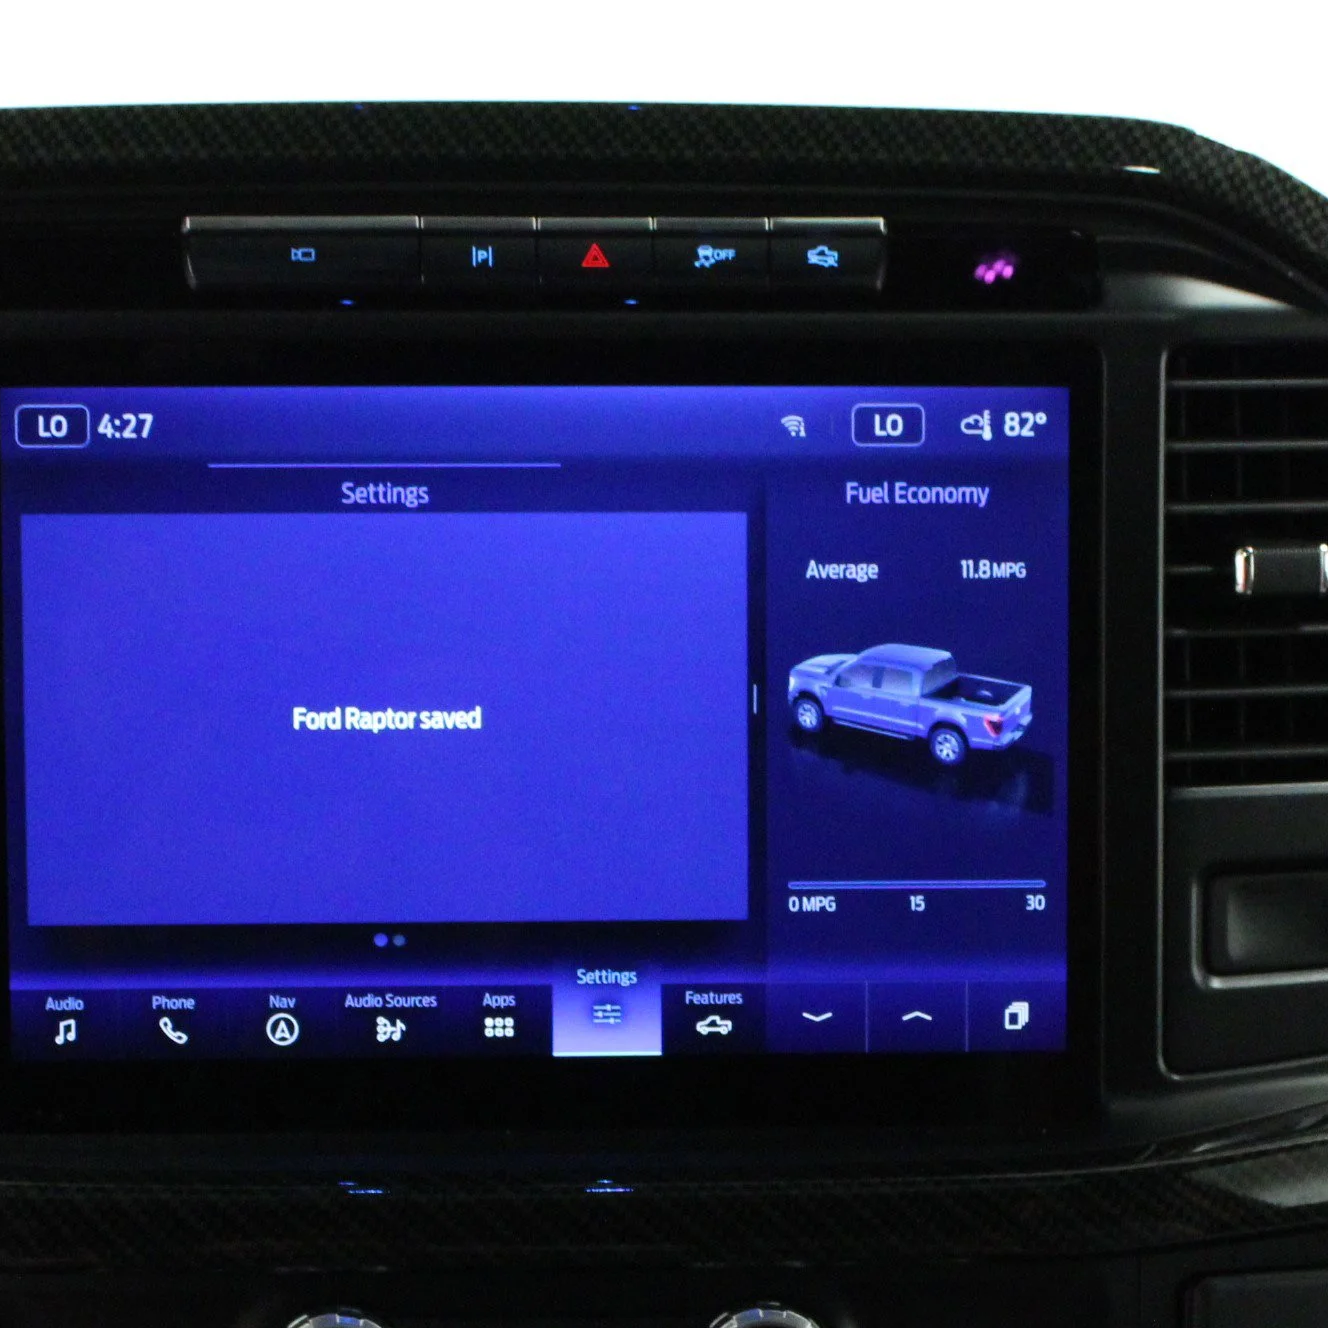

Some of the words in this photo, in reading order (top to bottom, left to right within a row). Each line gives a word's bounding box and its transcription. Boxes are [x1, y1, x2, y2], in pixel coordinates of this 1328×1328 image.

[713, 248, 736, 260] OFF
[37, 415, 67, 438] LO
[97, 414, 153, 439] 4:27
[874, 414, 903, 436] LO
[1004, 410, 1046, 436] 82°
[341, 482, 429, 507] Settings
[846, 482, 889, 503] Fuel
[895, 482, 989, 507] Economy
[806, 560, 879, 582] Average
[961, 560, 990, 579] 11.8
[993, 562, 1026, 578] MPG
[293, 707, 341, 730] Ford
[345, 707, 417, 733] Raptor
[420, 707, 481, 729] saved
[789, 897, 799, 911] 0
[802, 896, 836, 911] MPG
[910, 895, 925, 911] 15
[1026, 895, 1045, 910] 30
[577, 969, 637, 986] Settings
[45, 997, 84, 1011] Audio
[152, 996, 195, 1010] Phone
[270, 995, 295, 1009] Nav
[345, 994, 383, 1008] Audio
[386, 994, 436, 1008] Sources
[482, 993, 515, 1008] Apps
[685, 991, 742, 1005] Features
